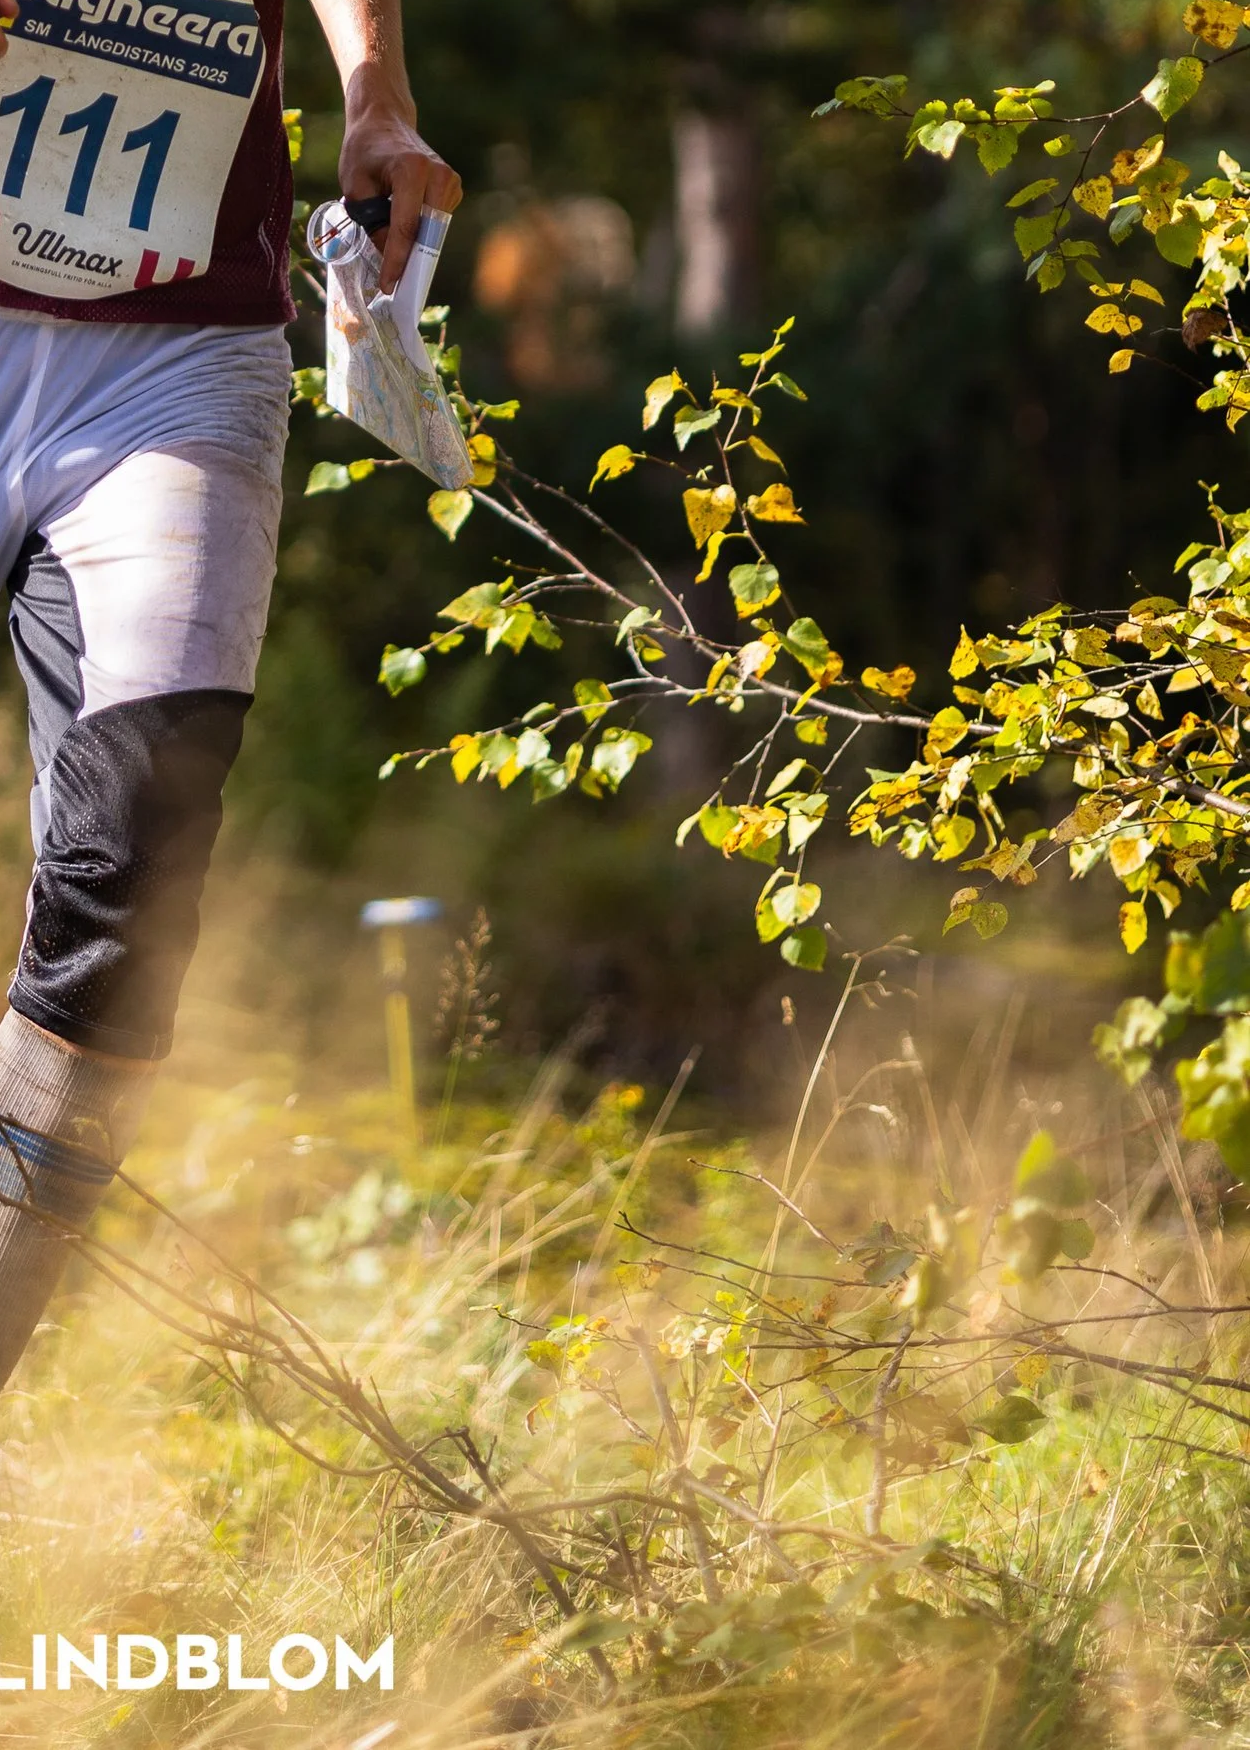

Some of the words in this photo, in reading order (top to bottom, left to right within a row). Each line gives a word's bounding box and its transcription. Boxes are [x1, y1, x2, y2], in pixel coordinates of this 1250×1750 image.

[24, 18, 51, 38] SM
[63, 29, 186, 73] LÅNGDISTANS
[188, 62, 229, 85] 2025
